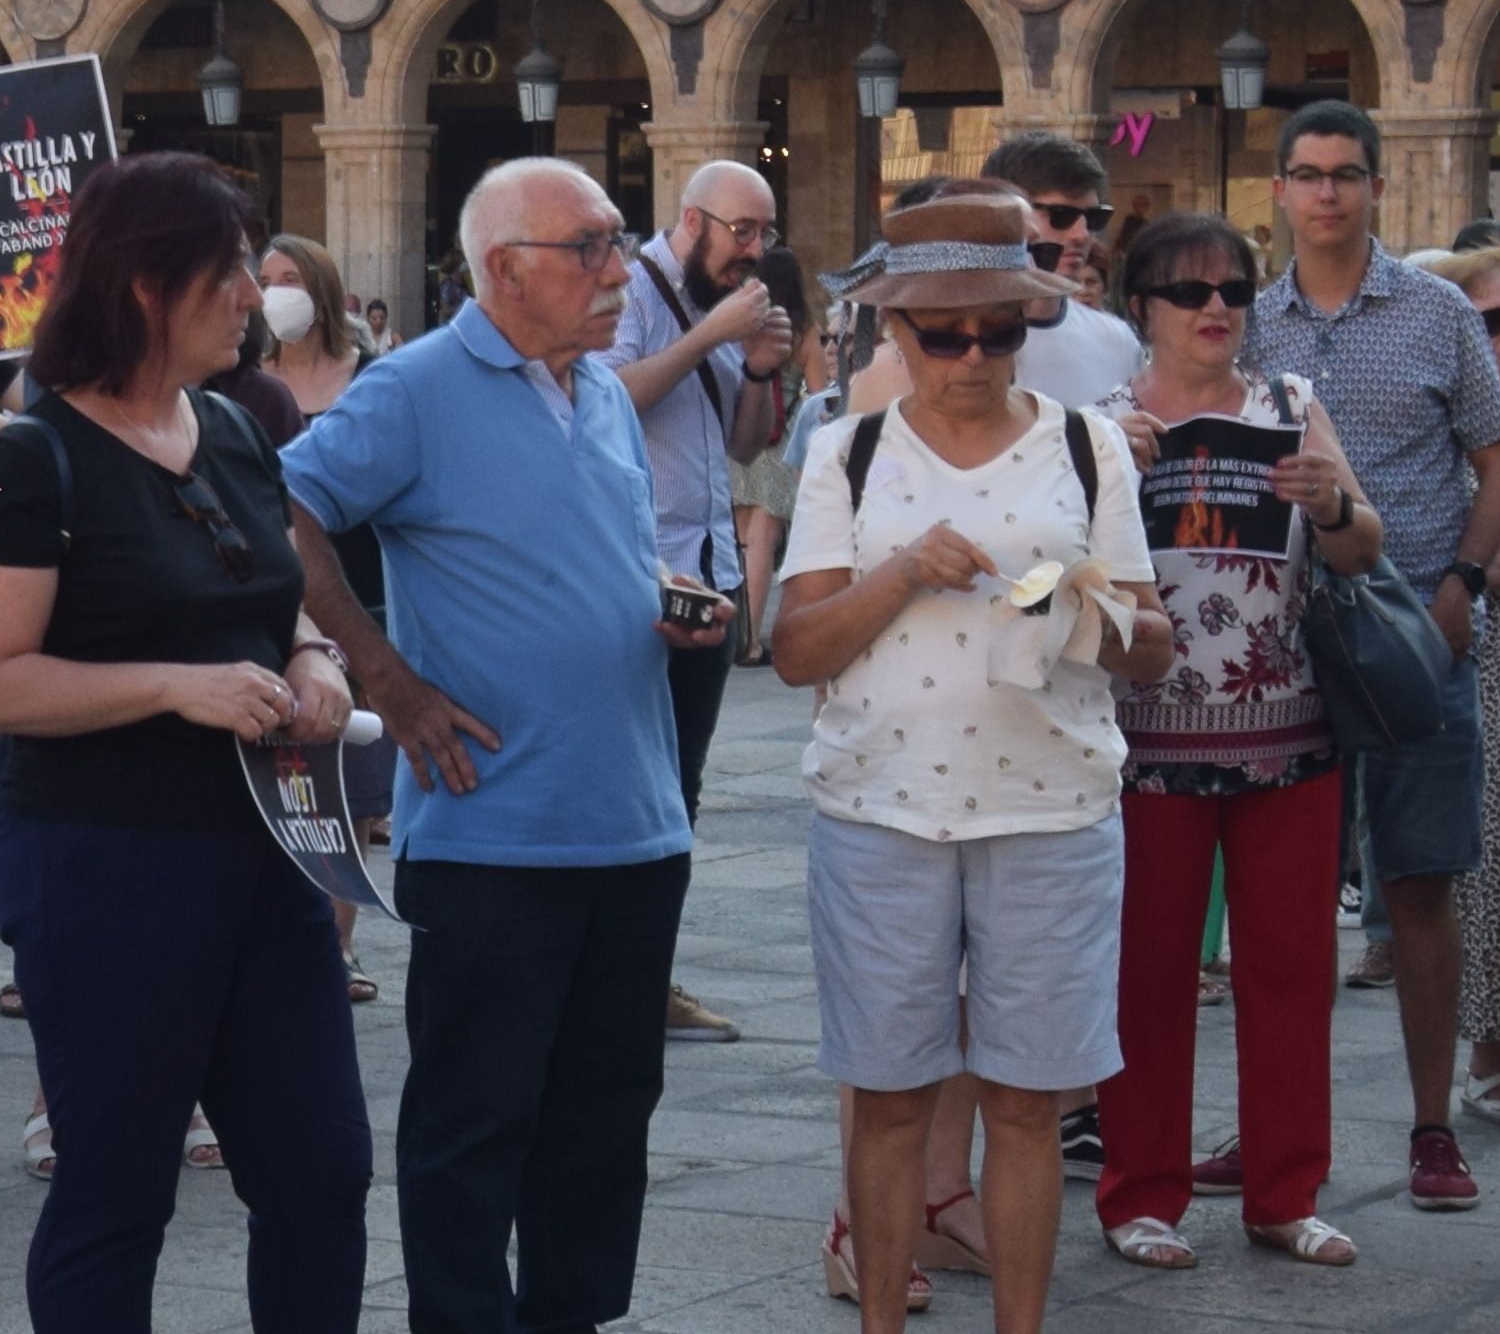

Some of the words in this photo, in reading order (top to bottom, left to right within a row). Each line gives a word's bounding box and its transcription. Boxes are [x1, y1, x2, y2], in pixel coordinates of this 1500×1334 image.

[78, 130, 96, 161] Y
[10, 164, 73, 202] LEÓN
[1206, 457, 1218, 471] LA
[1213, 475, 1231, 489] HAY
[285, 818, 347, 854] CASTILLA
